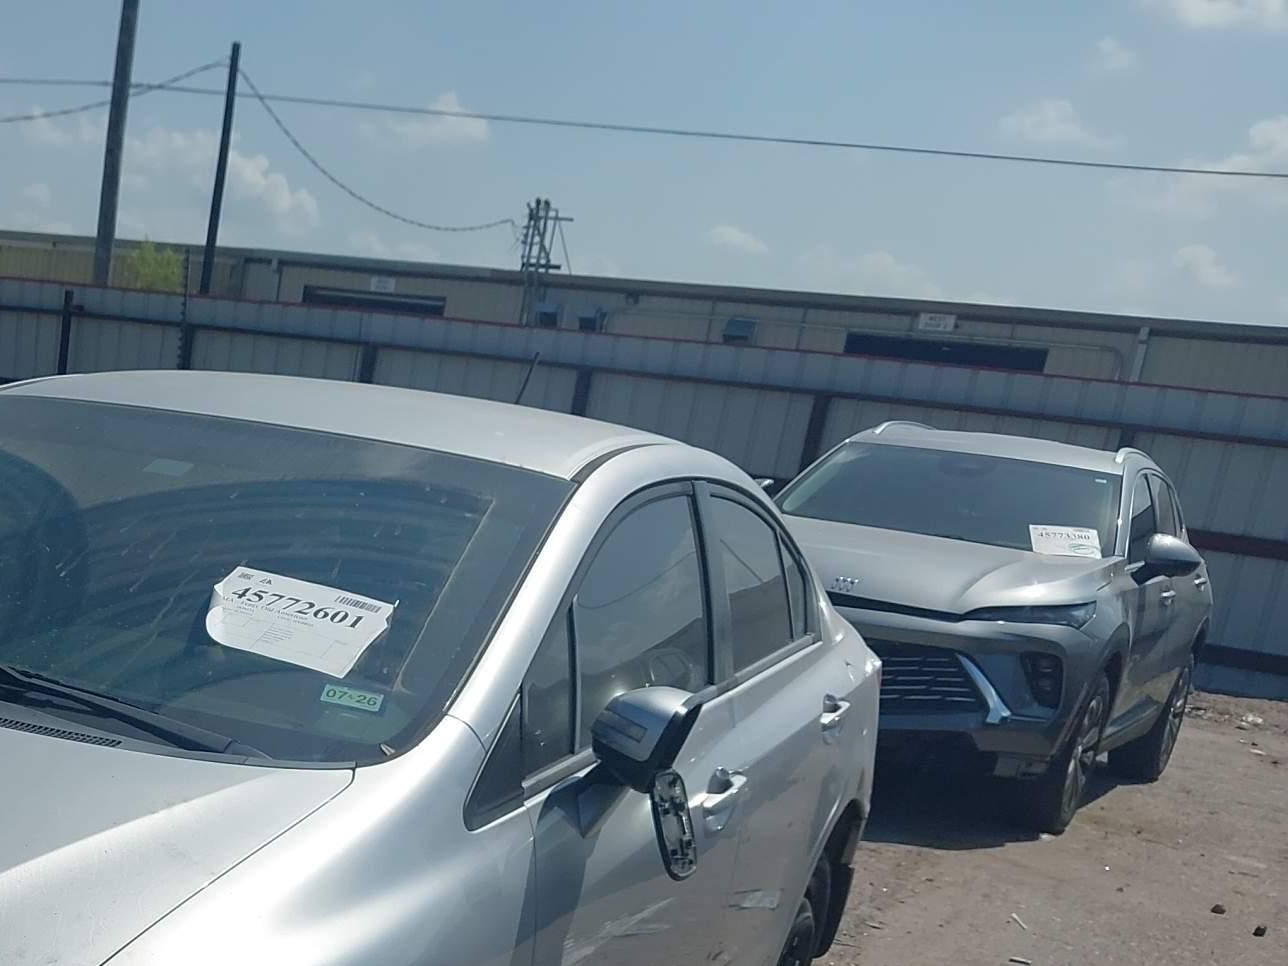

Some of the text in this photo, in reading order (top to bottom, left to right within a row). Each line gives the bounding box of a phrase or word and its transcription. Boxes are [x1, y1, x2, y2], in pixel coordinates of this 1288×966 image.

[232, 587, 365, 629] 45772601
[326, 688, 378, 706] 07 26
